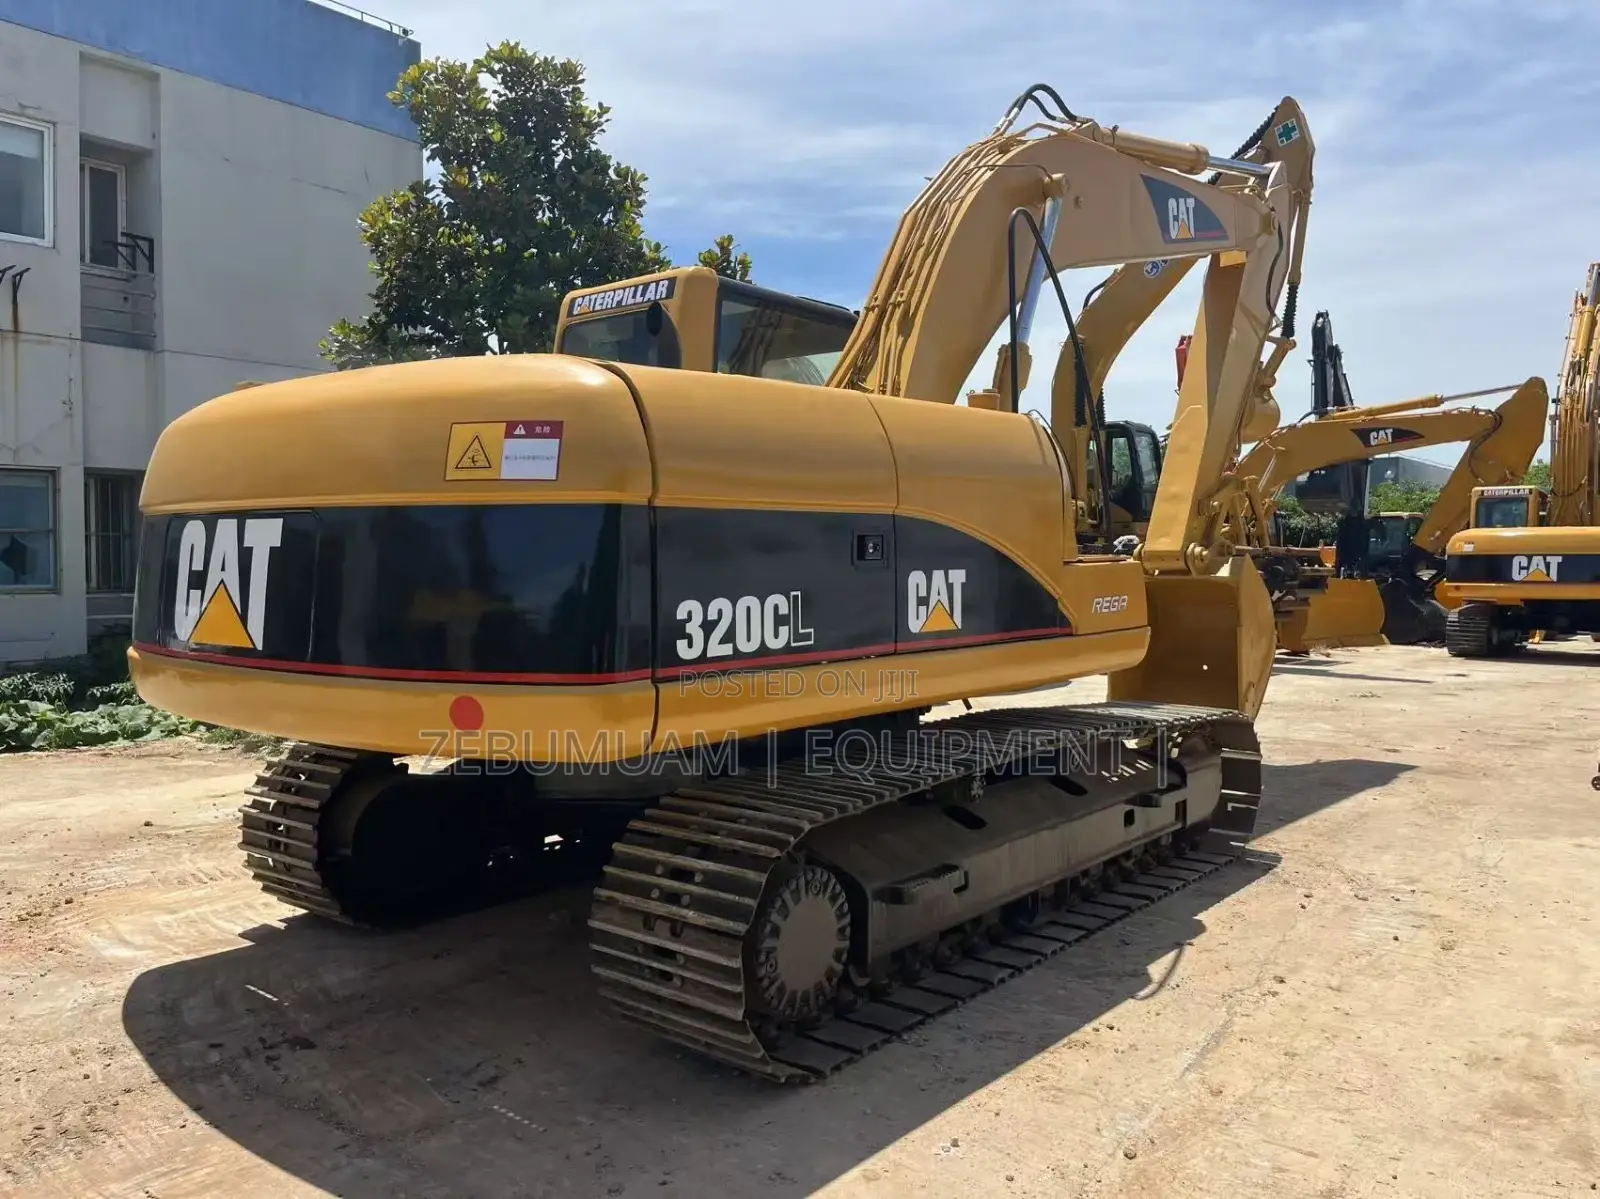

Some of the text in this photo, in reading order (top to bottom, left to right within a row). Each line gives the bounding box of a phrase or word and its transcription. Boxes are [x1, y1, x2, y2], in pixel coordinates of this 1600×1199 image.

[1168, 197, 1195, 240] CAT
[572, 279, 669, 316] CATERPILLAR
[1369, 428, 1393, 446] CAT
[1483, 488, 1530, 496] CATERPILLAR
[174, 518, 284, 651] CAT
[1511, 555, 1562, 582] CAT
[907, 569, 966, 634] CAT
[676, 591, 815, 660] 320CL
